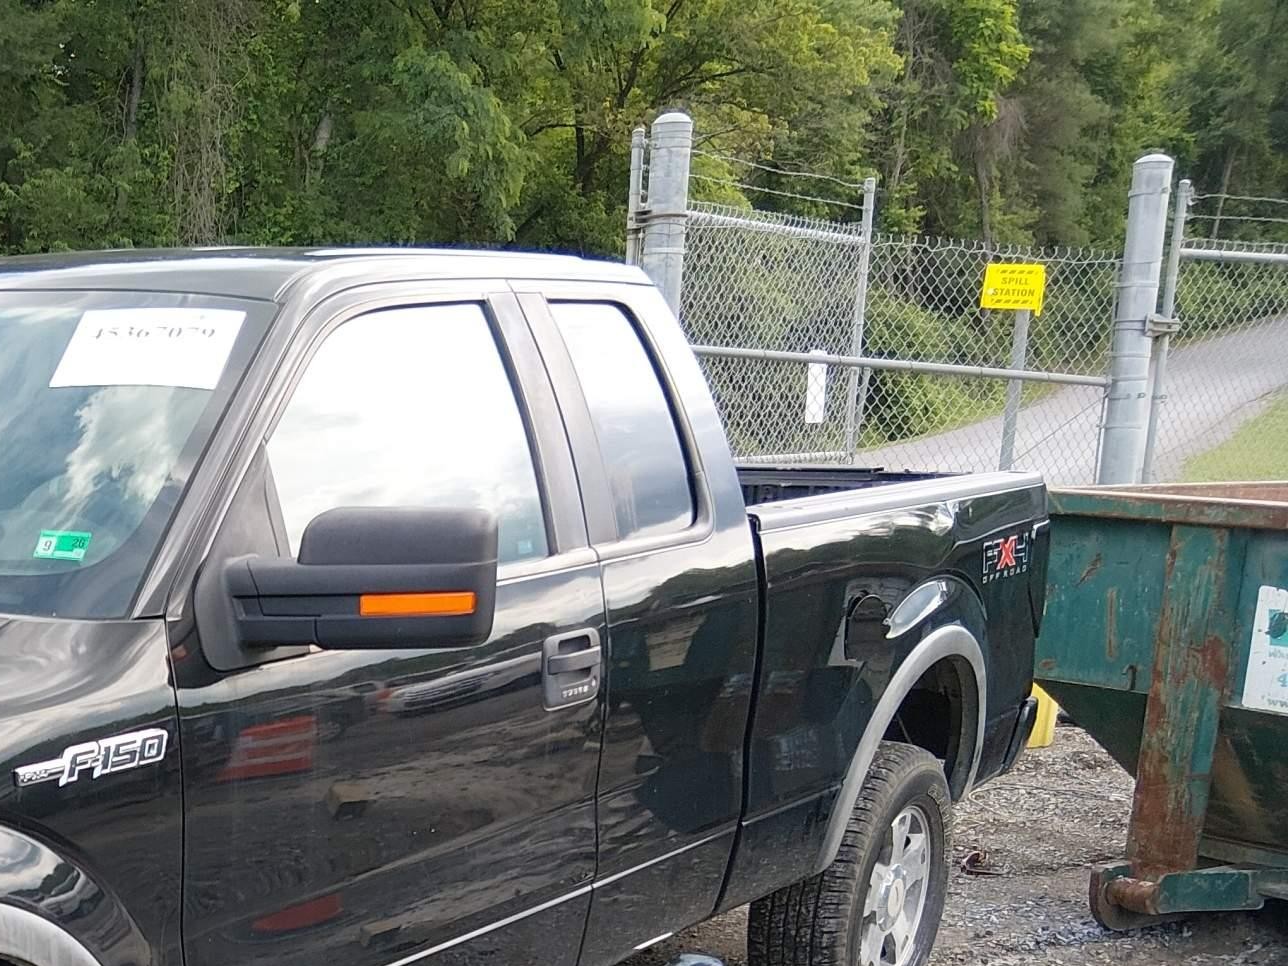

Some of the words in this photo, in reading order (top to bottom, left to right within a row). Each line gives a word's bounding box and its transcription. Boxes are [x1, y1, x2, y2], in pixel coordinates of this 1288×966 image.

[1001, 277, 1030, 286] SPILL
[992, 288, 1036, 297] STATION
[43, 540, 52, 551] 9
[982, 531, 1029, 574] FX4
